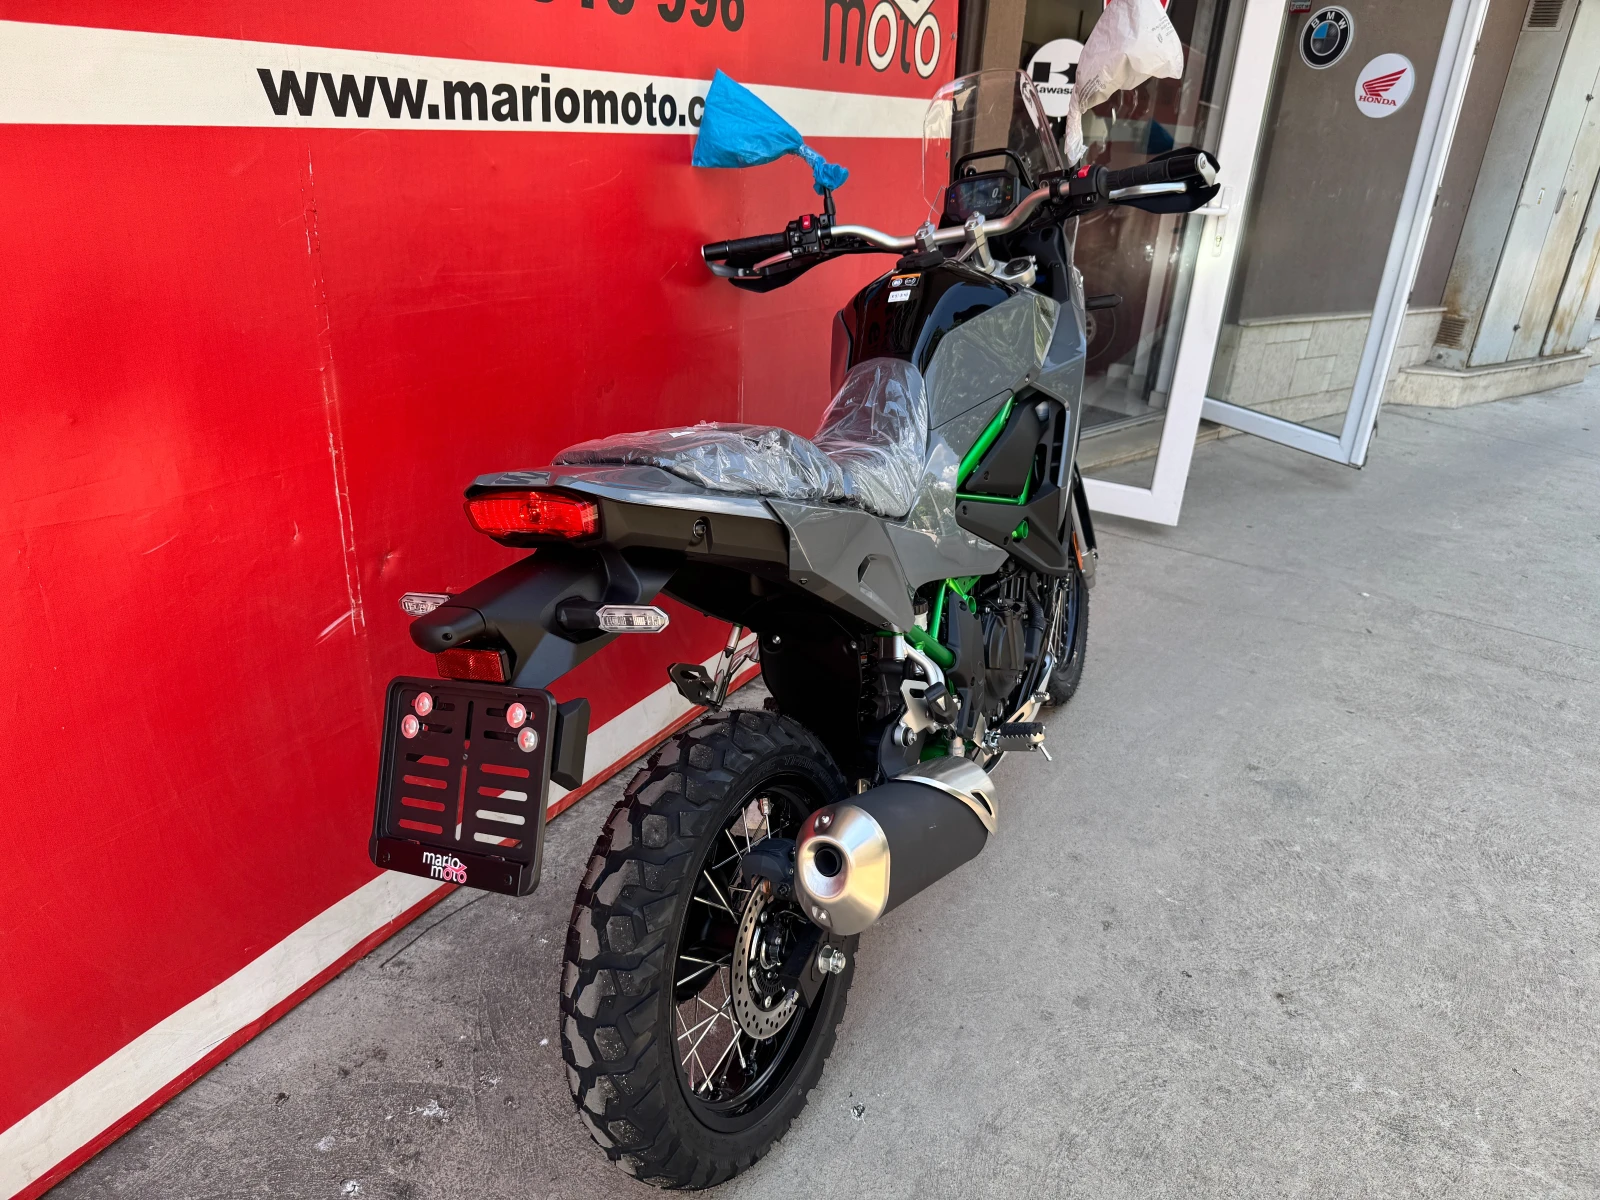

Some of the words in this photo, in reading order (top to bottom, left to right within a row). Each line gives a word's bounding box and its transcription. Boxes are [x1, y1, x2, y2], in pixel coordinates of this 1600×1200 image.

[1311, 11, 1347, 30] BMW
[1358, 95, 1397, 106] HONDA
[422, 851, 461, 869] mario
[430, 865, 467, 884] moto
